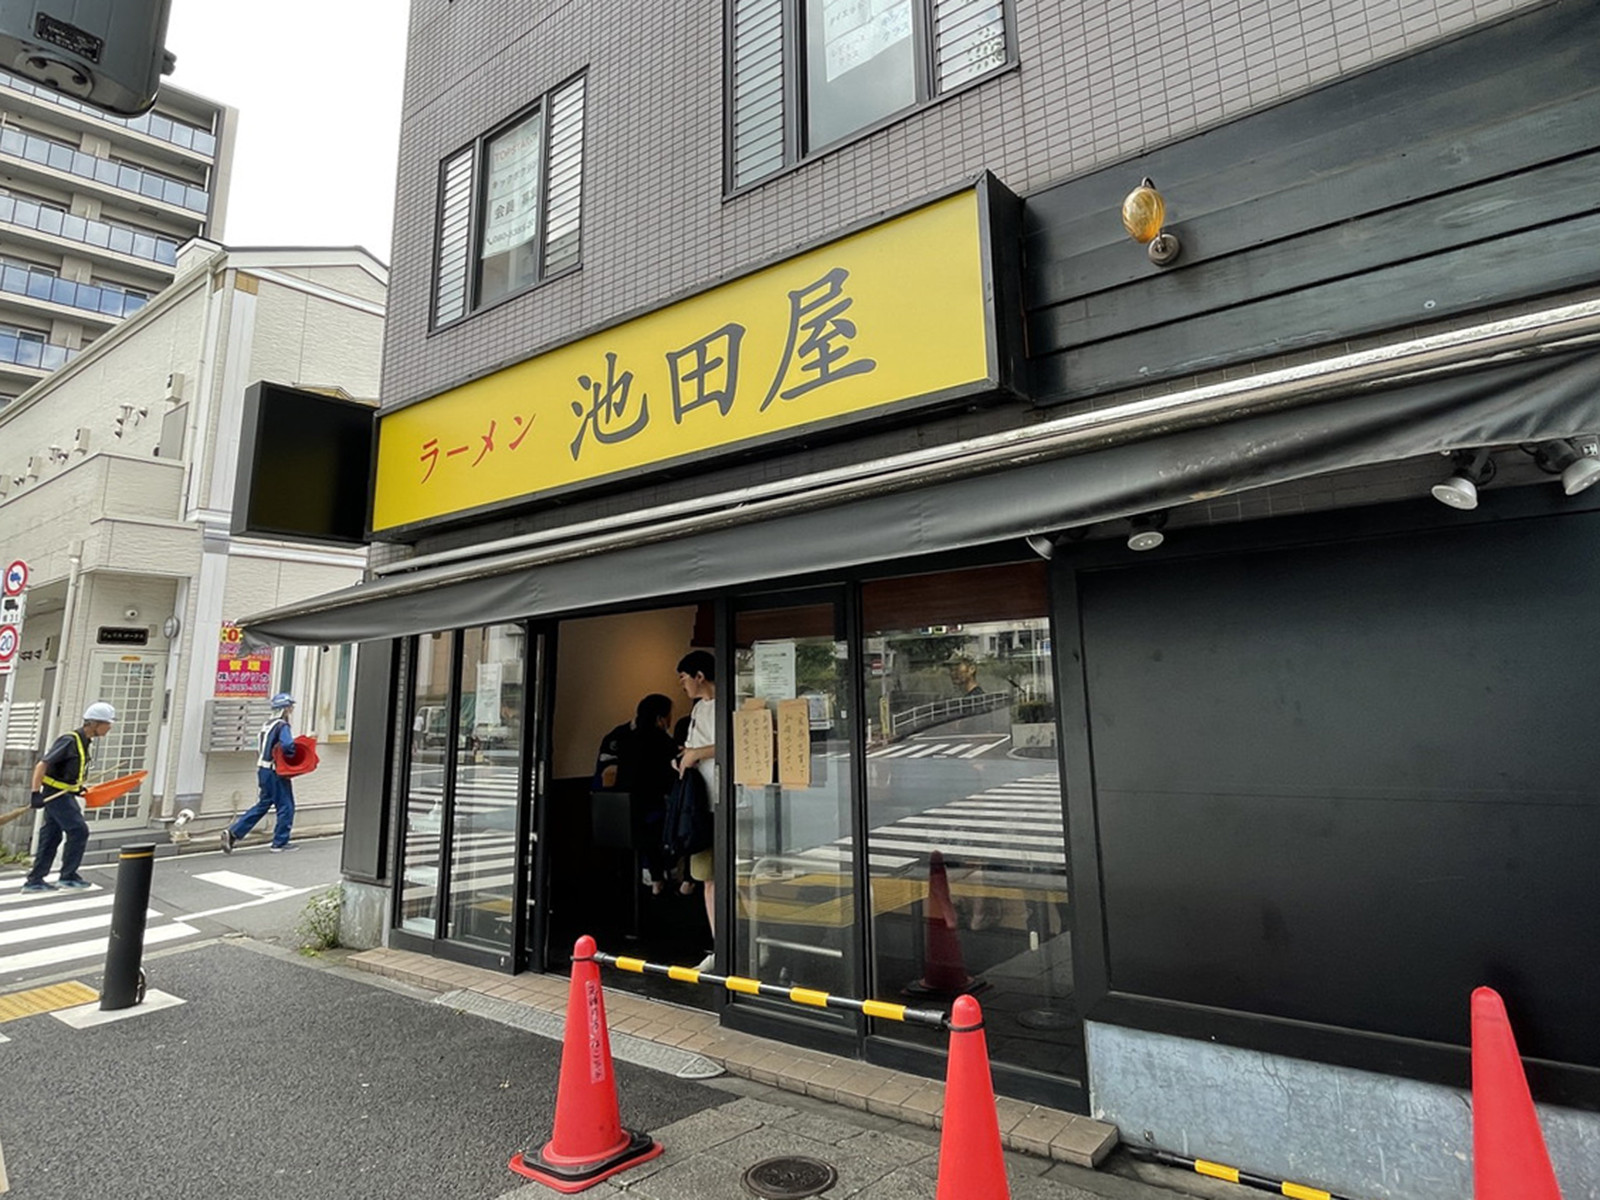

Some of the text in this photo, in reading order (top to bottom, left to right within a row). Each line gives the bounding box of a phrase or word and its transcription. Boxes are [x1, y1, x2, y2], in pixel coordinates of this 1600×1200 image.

[419, 267, 877, 485] ラーメン 池田屋
[0, 634, 13, 651] 20
